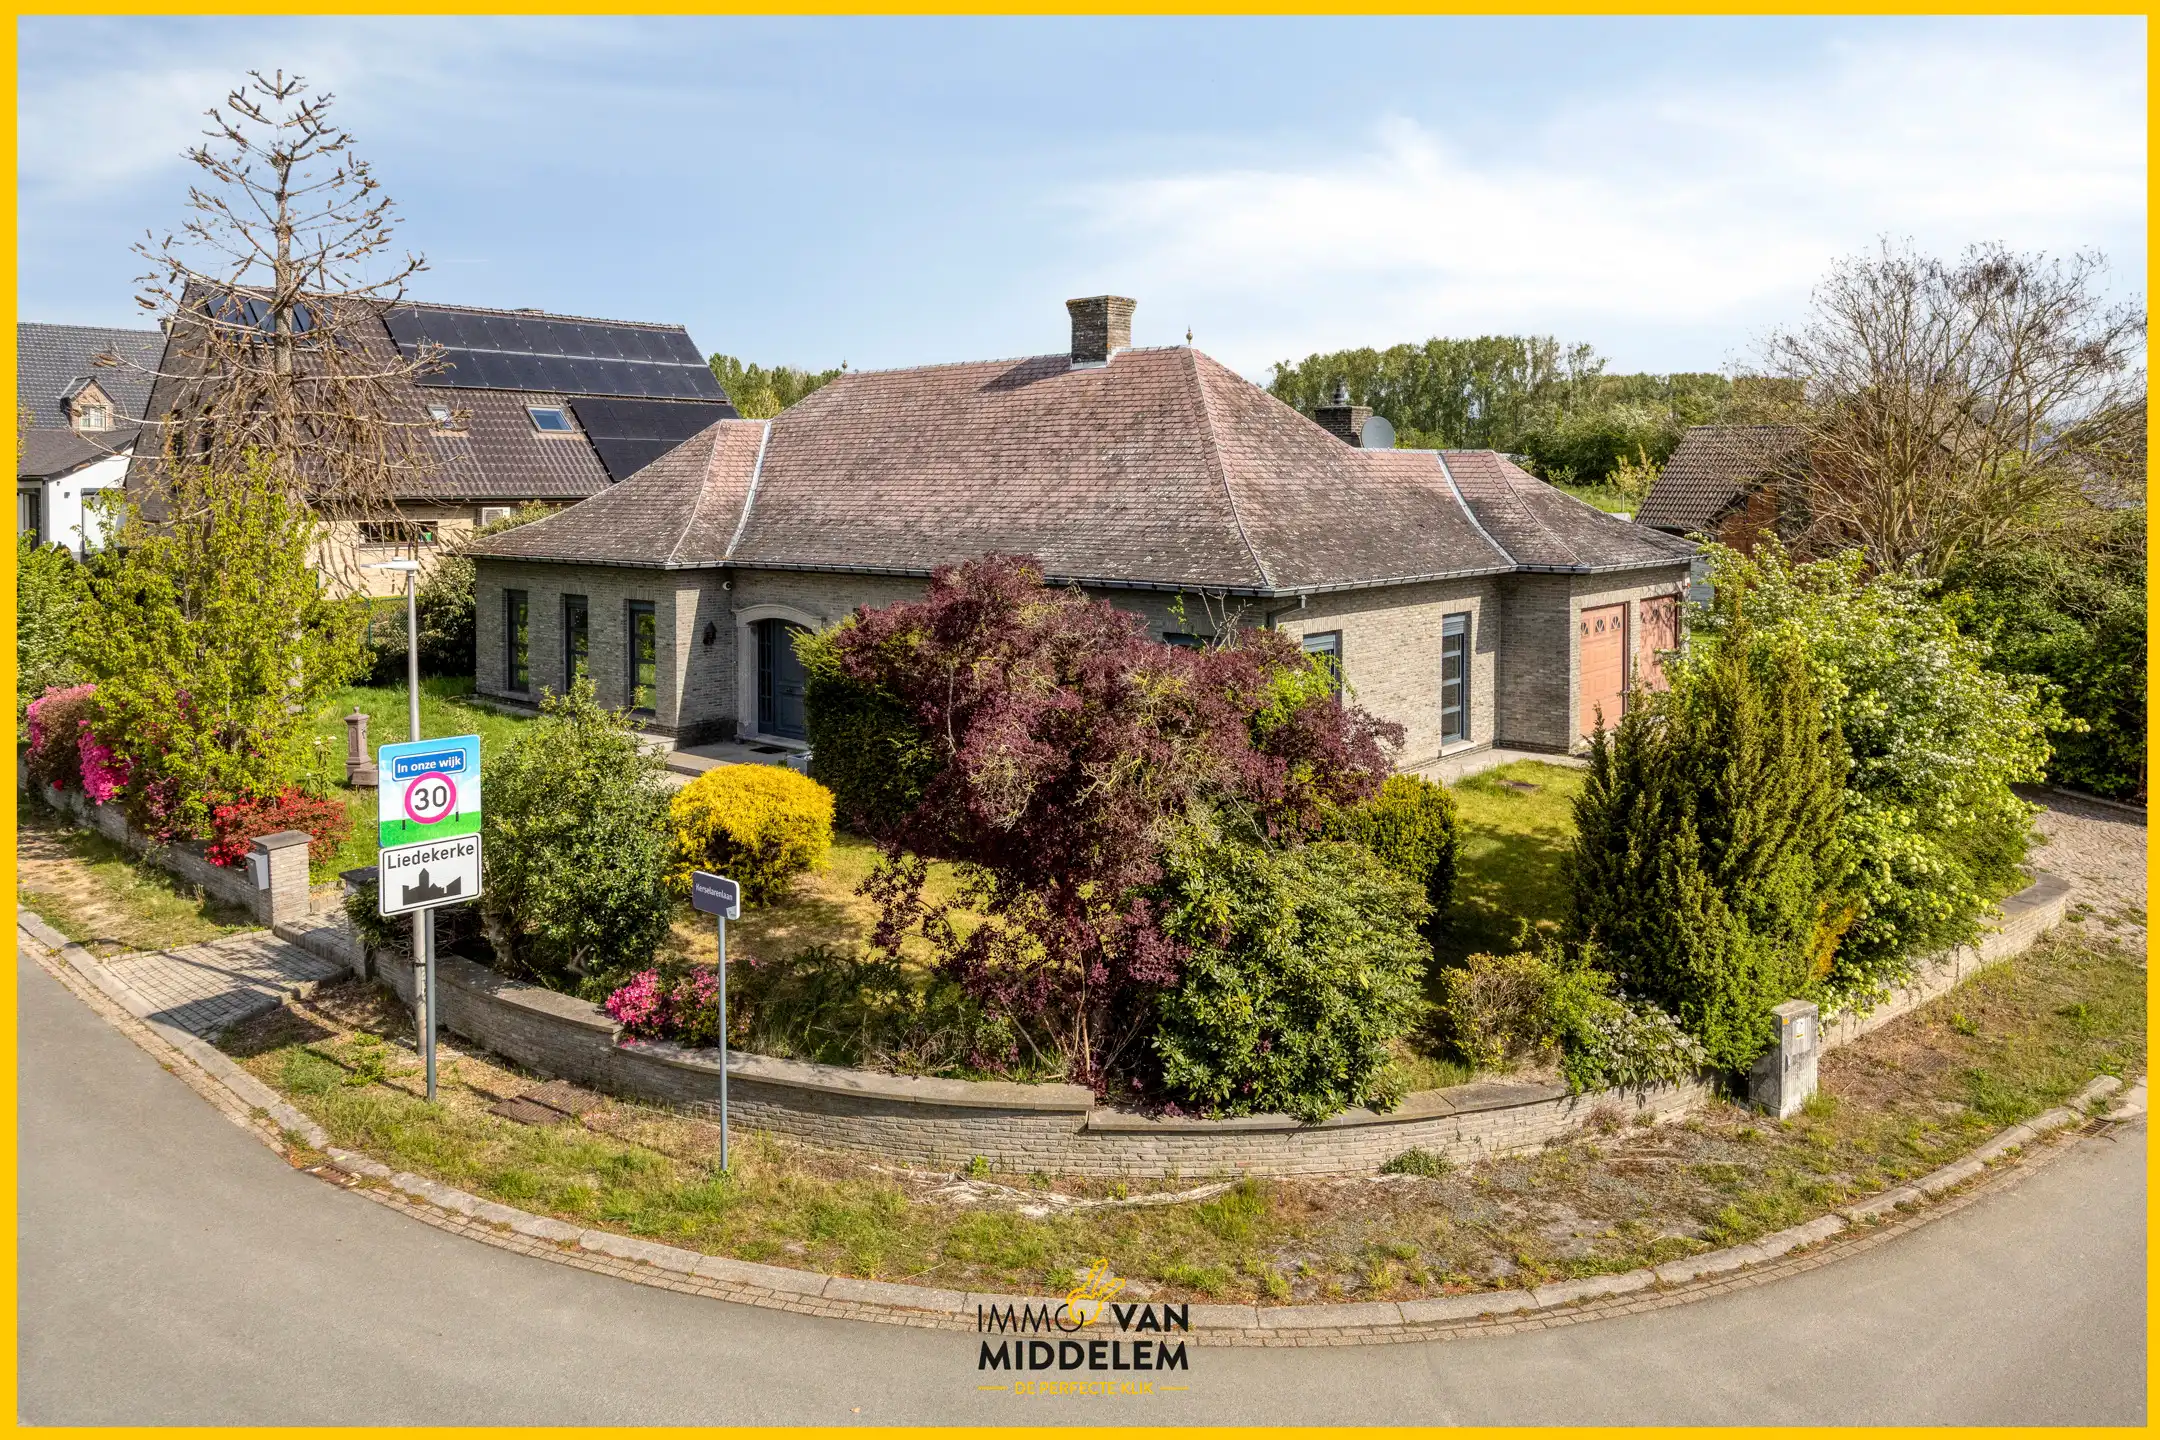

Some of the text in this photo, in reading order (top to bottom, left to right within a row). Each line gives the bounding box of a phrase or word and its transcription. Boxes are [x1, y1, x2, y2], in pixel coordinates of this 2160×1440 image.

[397, 755, 461, 774] In onze wijk
[414, 785, 447, 811] 30
[388, 843, 474, 869] Liedekerke
